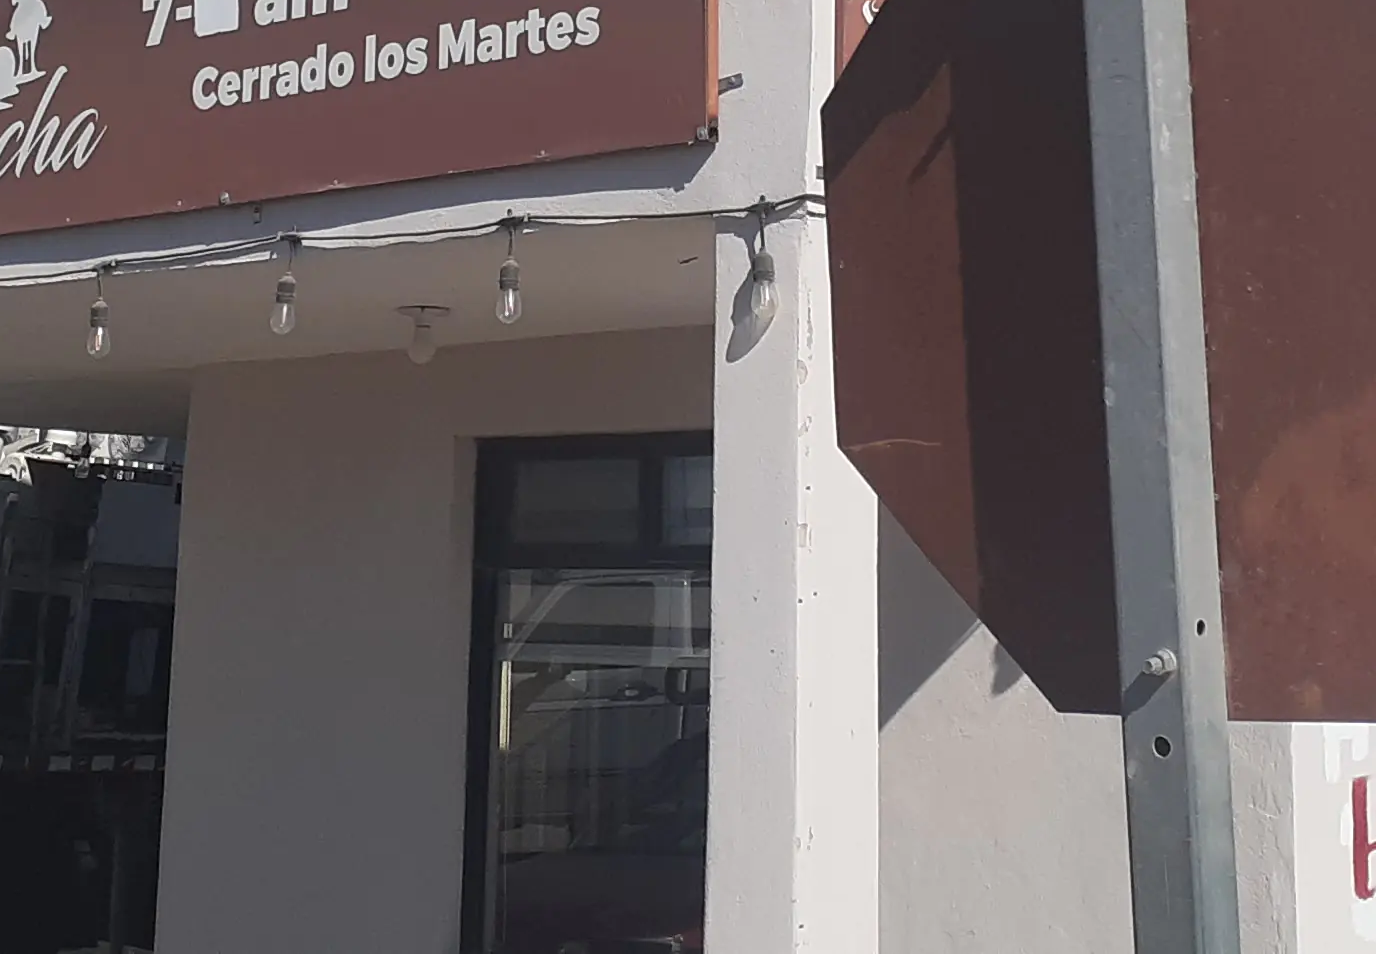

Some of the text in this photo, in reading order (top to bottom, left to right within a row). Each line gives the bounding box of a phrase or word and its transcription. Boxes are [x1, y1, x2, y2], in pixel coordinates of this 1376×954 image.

[192, 6, 601, 111] Cerrado los Martes
